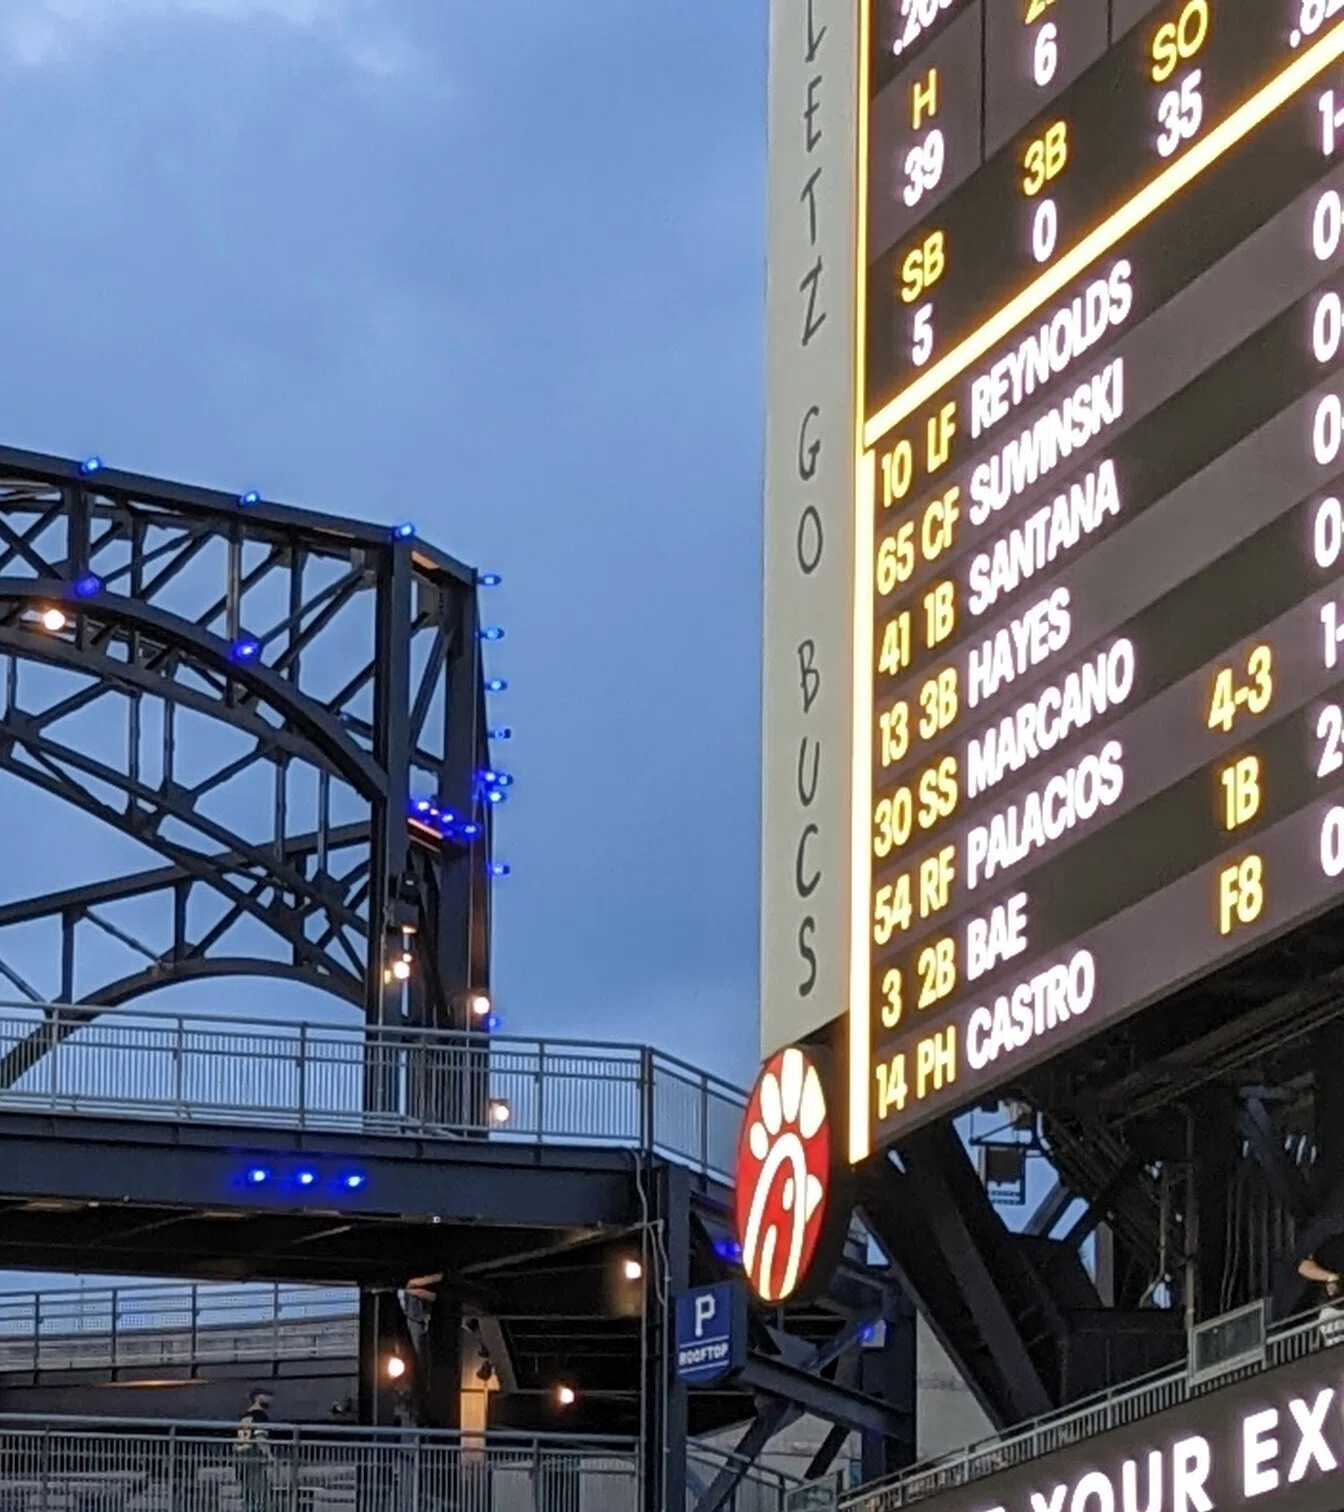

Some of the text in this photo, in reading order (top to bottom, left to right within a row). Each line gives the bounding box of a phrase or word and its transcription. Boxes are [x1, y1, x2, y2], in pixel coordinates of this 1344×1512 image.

[912, 68, 937, 130] H
[1033, 21, 1058, 87] 6
[1151, 0, 1209, 82] SO
[902, 128, 945, 207] 39
[1022, 120, 1068, 196] 3B
[1156, 68, 1203, 158] 35
[900, 230, 945, 303] SB
[1031, 198, 1058, 263] 0
[880, 439, 913, 509] 10
[926, 401, 957, 474] LF
[970, 259, 1133, 439] REYNOLDS
[911, 303, 934, 367] 5
[797, 405, 824, 575] GO
[875, 520, 915, 596] 65
[921, 485, 960, 561] CF
[968, 356, 1124, 526] SUWINSKI
[877, 610, 911, 676] 41
[923, 580, 955, 649] 1B
[968, 458, 1121, 616] SANTANA
[878, 700, 909, 768] 13
[918, 666, 959, 740] 3B
[967, 586, 1071, 709] HAYES
[873, 786, 913, 858] 30
[917, 756, 959, 829] SS
[967, 637, 1135, 799] MARCANO
[873, 873, 913, 946] 54
[919, 844, 956, 919] RF
[966, 740, 1124, 890] PALACIOS
[1207, 645, 1273, 732] 4-3
[795, 640, 822, 998] BUCS
[881, 967, 903, 1028] 3
[917, 937, 957, 1010] 2B
[966, 891, 1028, 982] BAE
[1221, 755, 1260, 831] 1B
[875, 1053, 909, 1120] 14
[916, 1024, 956, 1099] PH
[965, 949, 1096, 1070] CASTRO
[1220, 854, 1264, 935] F8
[695, 1294, 715, 1337] P
